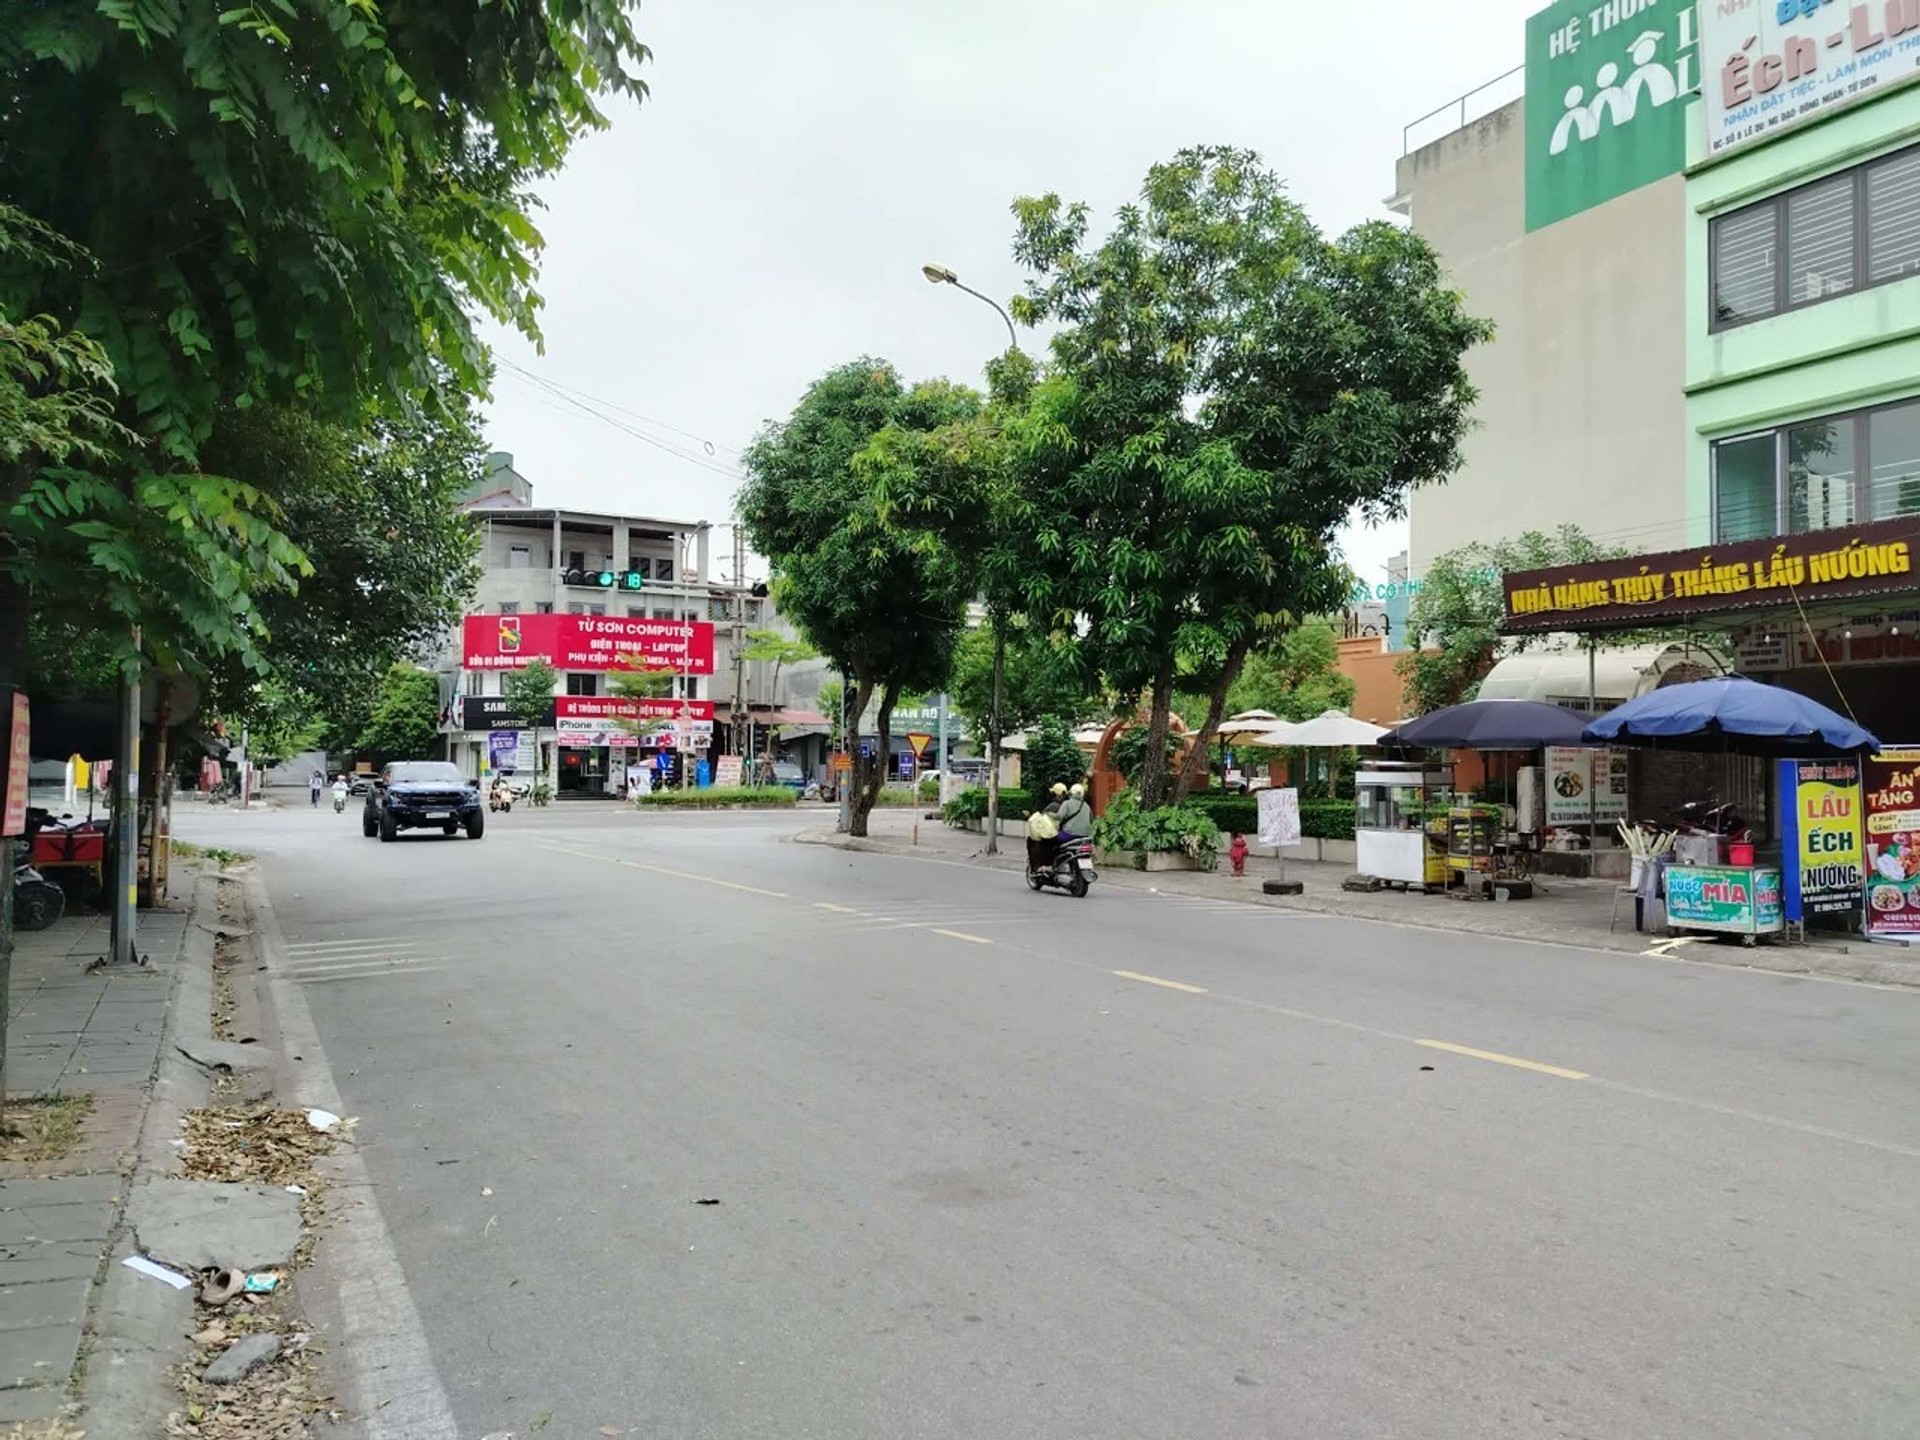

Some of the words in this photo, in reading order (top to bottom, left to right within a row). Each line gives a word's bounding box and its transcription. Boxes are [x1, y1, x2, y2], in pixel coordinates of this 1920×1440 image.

[1550, 16, 1581, 59] HỆ
[1721, 35, 1817, 109] Ếch
[1511, 581, 1551, 615] NHÀ
[1553, 578, 1610, 609] HÀNG
[1611, 565, 1666, 603] THỦY
[1670, 555, 1750, 599] THẮNG
[1753, 544, 1806, 590] LẨU
[1809, 538, 1910, 584] NƯỚNG
[578, 617, 595, 632] TỪ
[597, 620, 624, 634] SƠN
[626, 624, 695, 638] COMPUTER
[568, 653, 587, 664] PHỤ
[588, 651, 609, 665] KIỆN
[559, 720, 592, 729] iPhone
[1890, 771, 1914, 788] ĂN
[1867, 788, 1915, 809] TẶNG
[1808, 827, 1854, 853] ẾCH
[1807, 863, 1857, 888] NƯỚNG
[1702, 879, 1749, 905] MÍA
